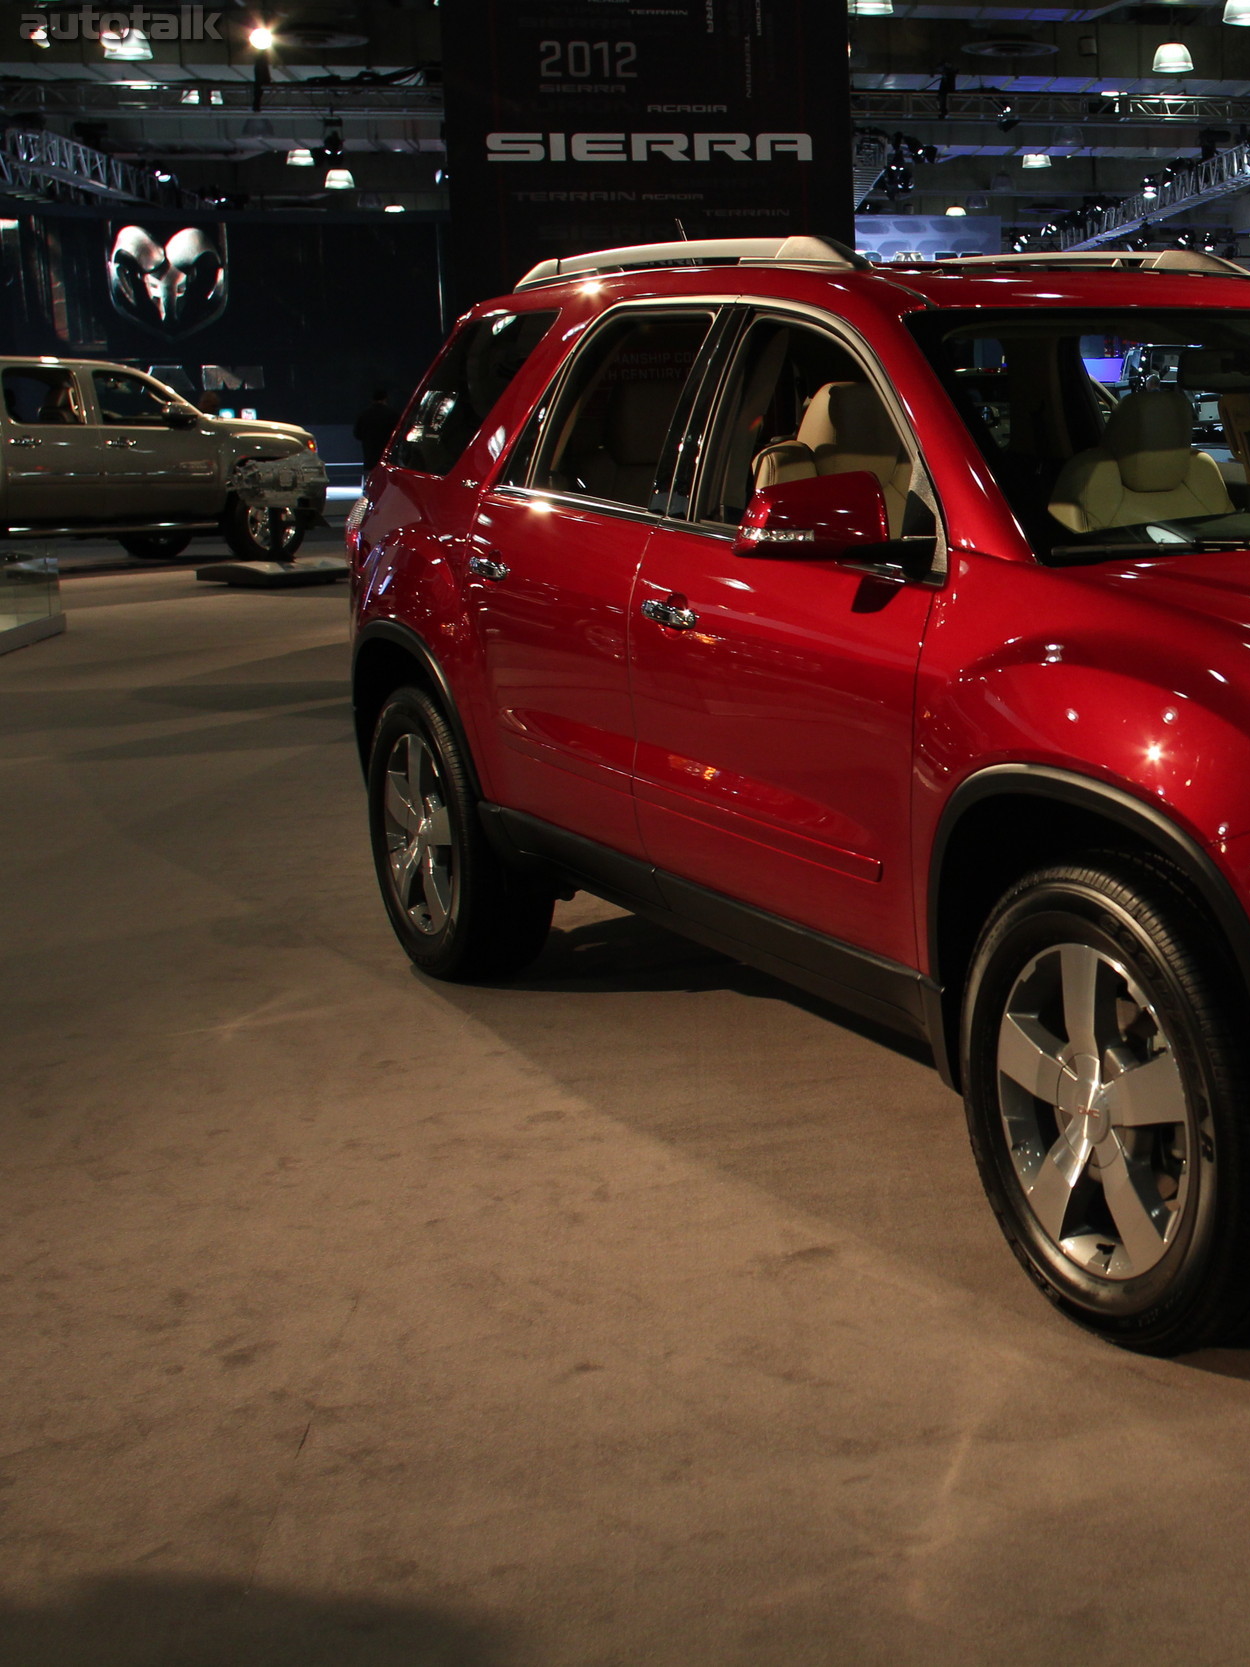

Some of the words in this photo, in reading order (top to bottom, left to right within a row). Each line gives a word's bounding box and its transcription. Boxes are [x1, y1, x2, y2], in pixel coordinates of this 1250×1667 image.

[628, 8, 689, 16] TERRAIN
[539, 40, 638, 78] 2012
[539, 83, 627, 94] SIERRA
[647, 104, 728, 113] ACADIA
[486, 132, 813, 162] SIERRA
[512, 191, 636, 202] TERRAIN
[641, 193, 704, 201] ACADIA
[702, 209, 791, 217] TERRAIN
